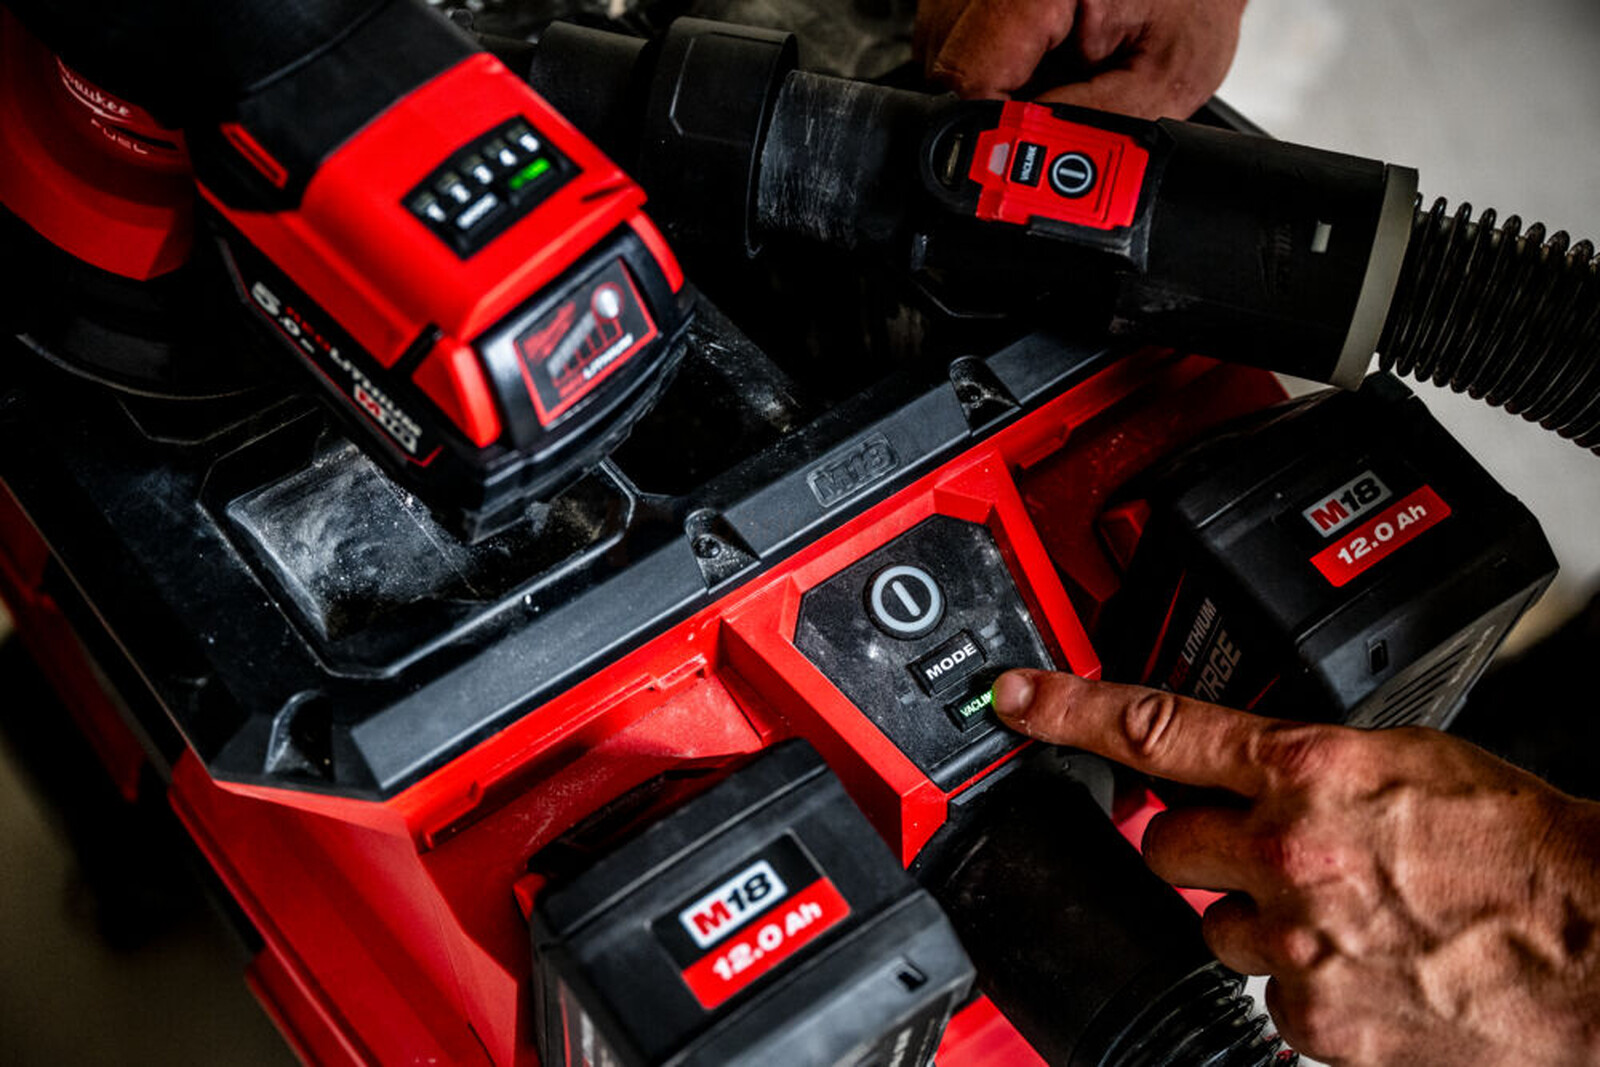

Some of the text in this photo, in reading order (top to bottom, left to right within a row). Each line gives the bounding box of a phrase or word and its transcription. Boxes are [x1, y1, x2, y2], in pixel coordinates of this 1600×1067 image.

[1310, 477, 1382, 532] M18
[1337, 504, 1427, 565] 12.0 Ah
[925, 642, 977, 680] MODE
[692, 872, 772, 936] M18
[712, 923, 784, 982] 12.0
